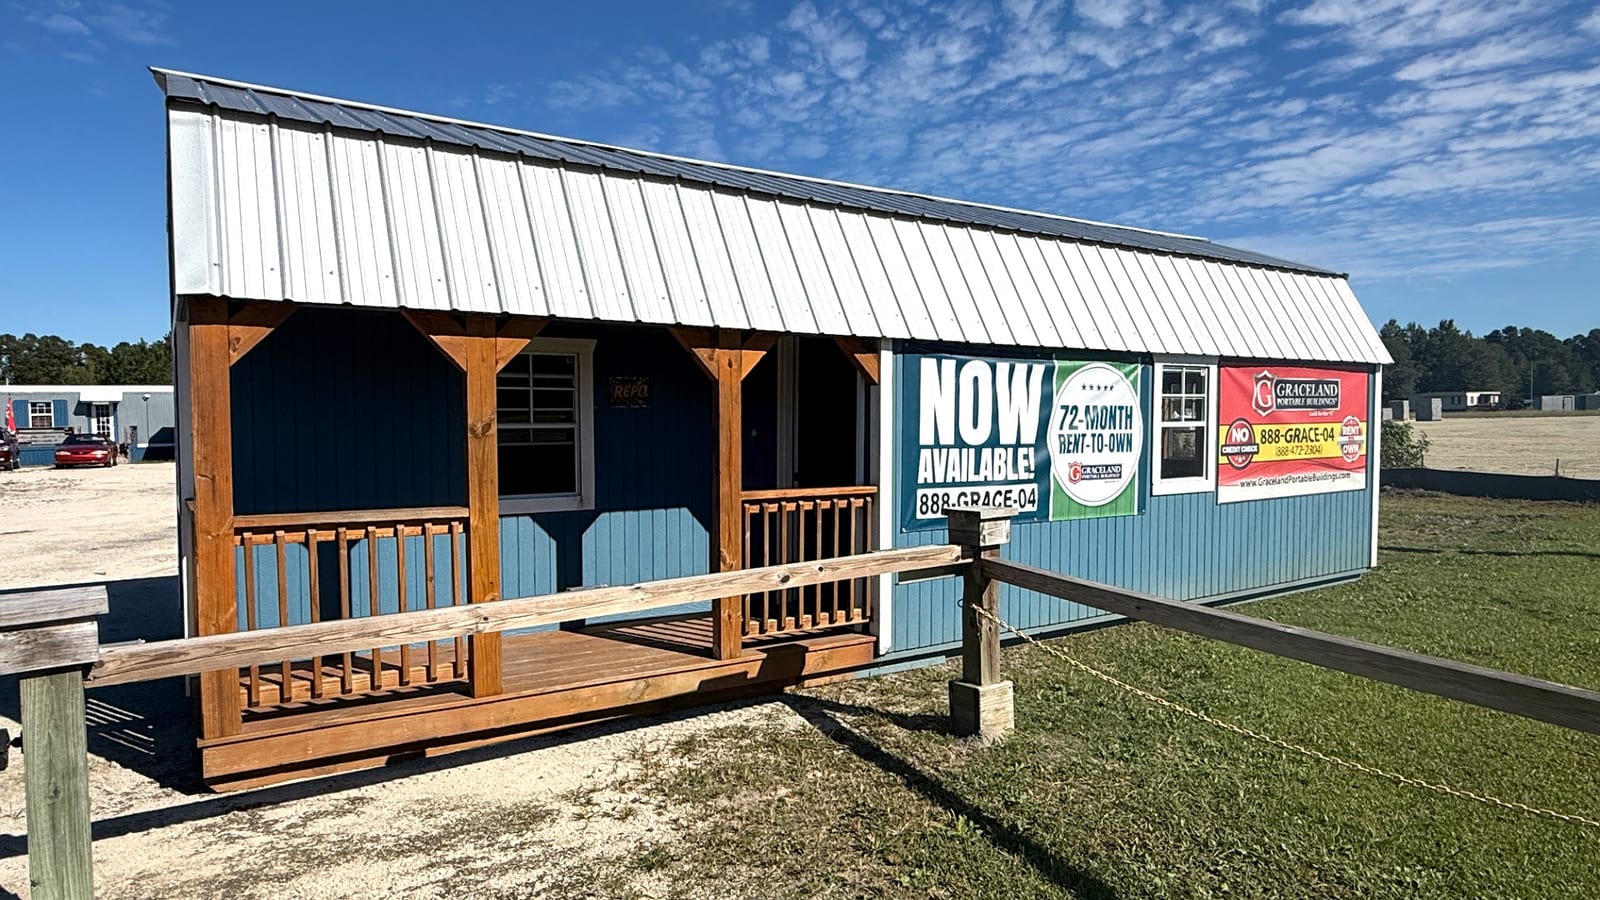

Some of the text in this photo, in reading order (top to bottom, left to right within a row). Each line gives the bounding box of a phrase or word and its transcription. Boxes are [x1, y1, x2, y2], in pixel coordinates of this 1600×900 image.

[1257, 380, 1272, 407] G
[1277, 383, 1338, 397] GRACELAND
[919, 357, 1046, 446] NOW
[1059, 404, 1133, 430] 72-MONTH
[1232, 427, 1250, 443] NO
[1260, 426, 1335, 444] 888-GRACE-04
[1342, 426, 1360, 436] RENT
[1058, 432, 1133, 454] RENT-TO-OWN
[1275, 444, 1323, 457] (888-472-2304)
[917, 447, 1036, 485] AVAILABLE!
[1082, 465, 1121, 474] GRACELAND
[1240, 471, 1351, 488] www.GracelandPortableBuildings.com
